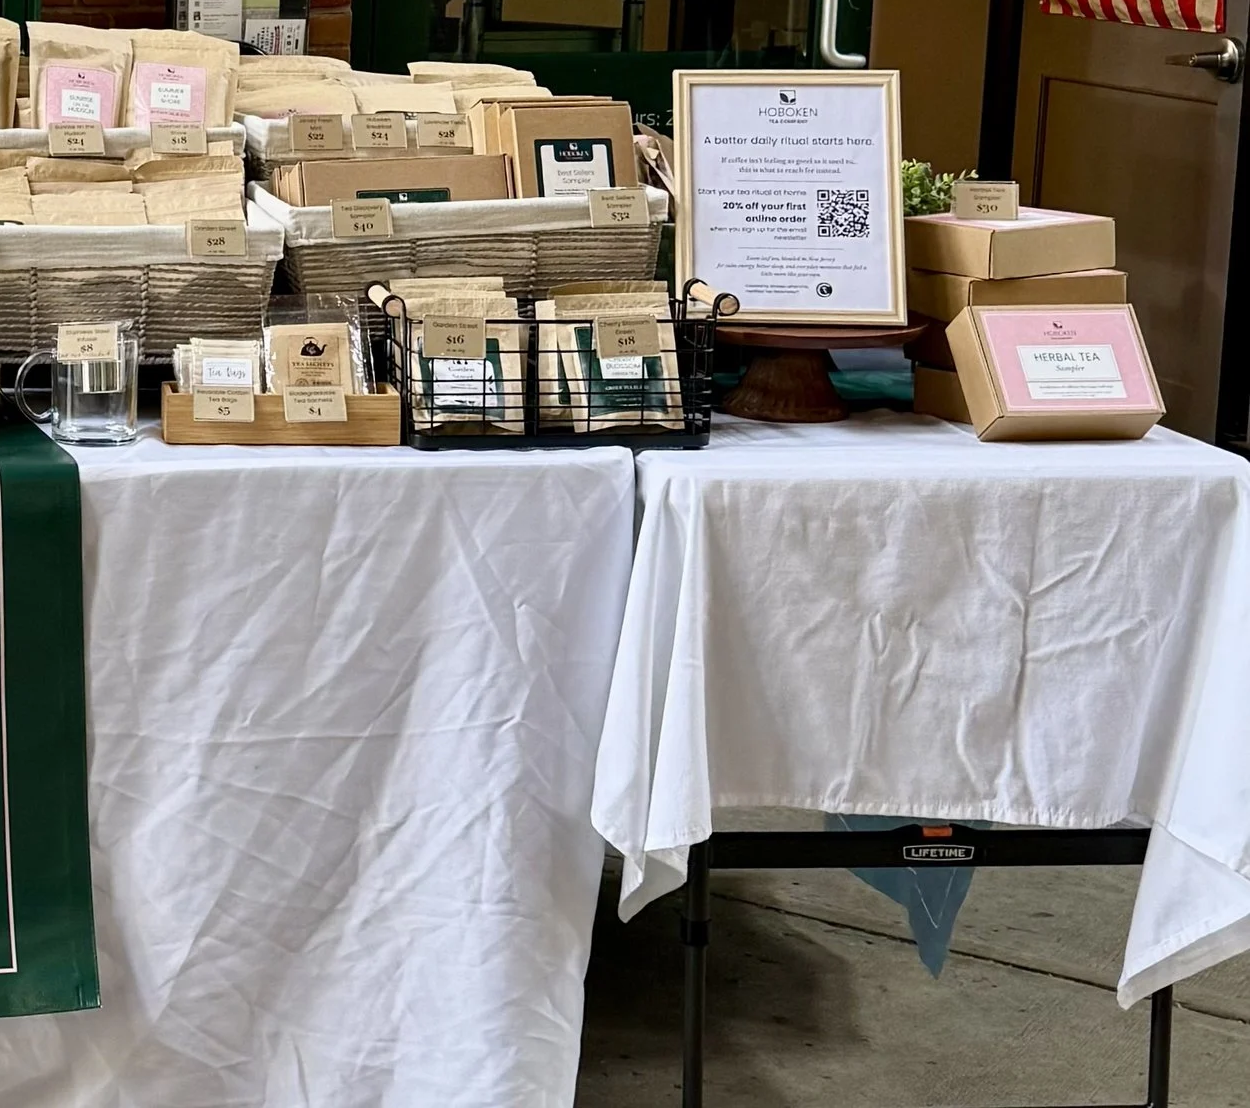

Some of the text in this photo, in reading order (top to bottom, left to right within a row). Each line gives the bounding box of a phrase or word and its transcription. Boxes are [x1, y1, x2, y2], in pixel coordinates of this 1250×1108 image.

[759, 108, 818, 117] HOBOKEN
[438, 130, 455, 138] $28
[172, 136, 187, 145] $18
[751, 137, 777, 147] daily
[781, 137, 808, 145] ritual
[812, 137, 843, 146] starts
[847, 137, 875, 146] here.
[723, 202, 806, 212] 20% off your first
[976, 203, 998, 213] $30
[611, 211, 630, 222] $32
[746, 215, 777, 223] online
[353, 222, 373, 232] $40
[206, 236, 225, 247] $28
[446, 334, 465, 345] $16
[618, 336, 635, 347] $18
[81, 343, 94, 353] $8
[1034, 352, 1101, 362] HERBAL TEA
[1056, 364, 1085, 372] Sampler
[218, 406, 230, 416] $5
[911, 848, 966, 858] LIFETIME
